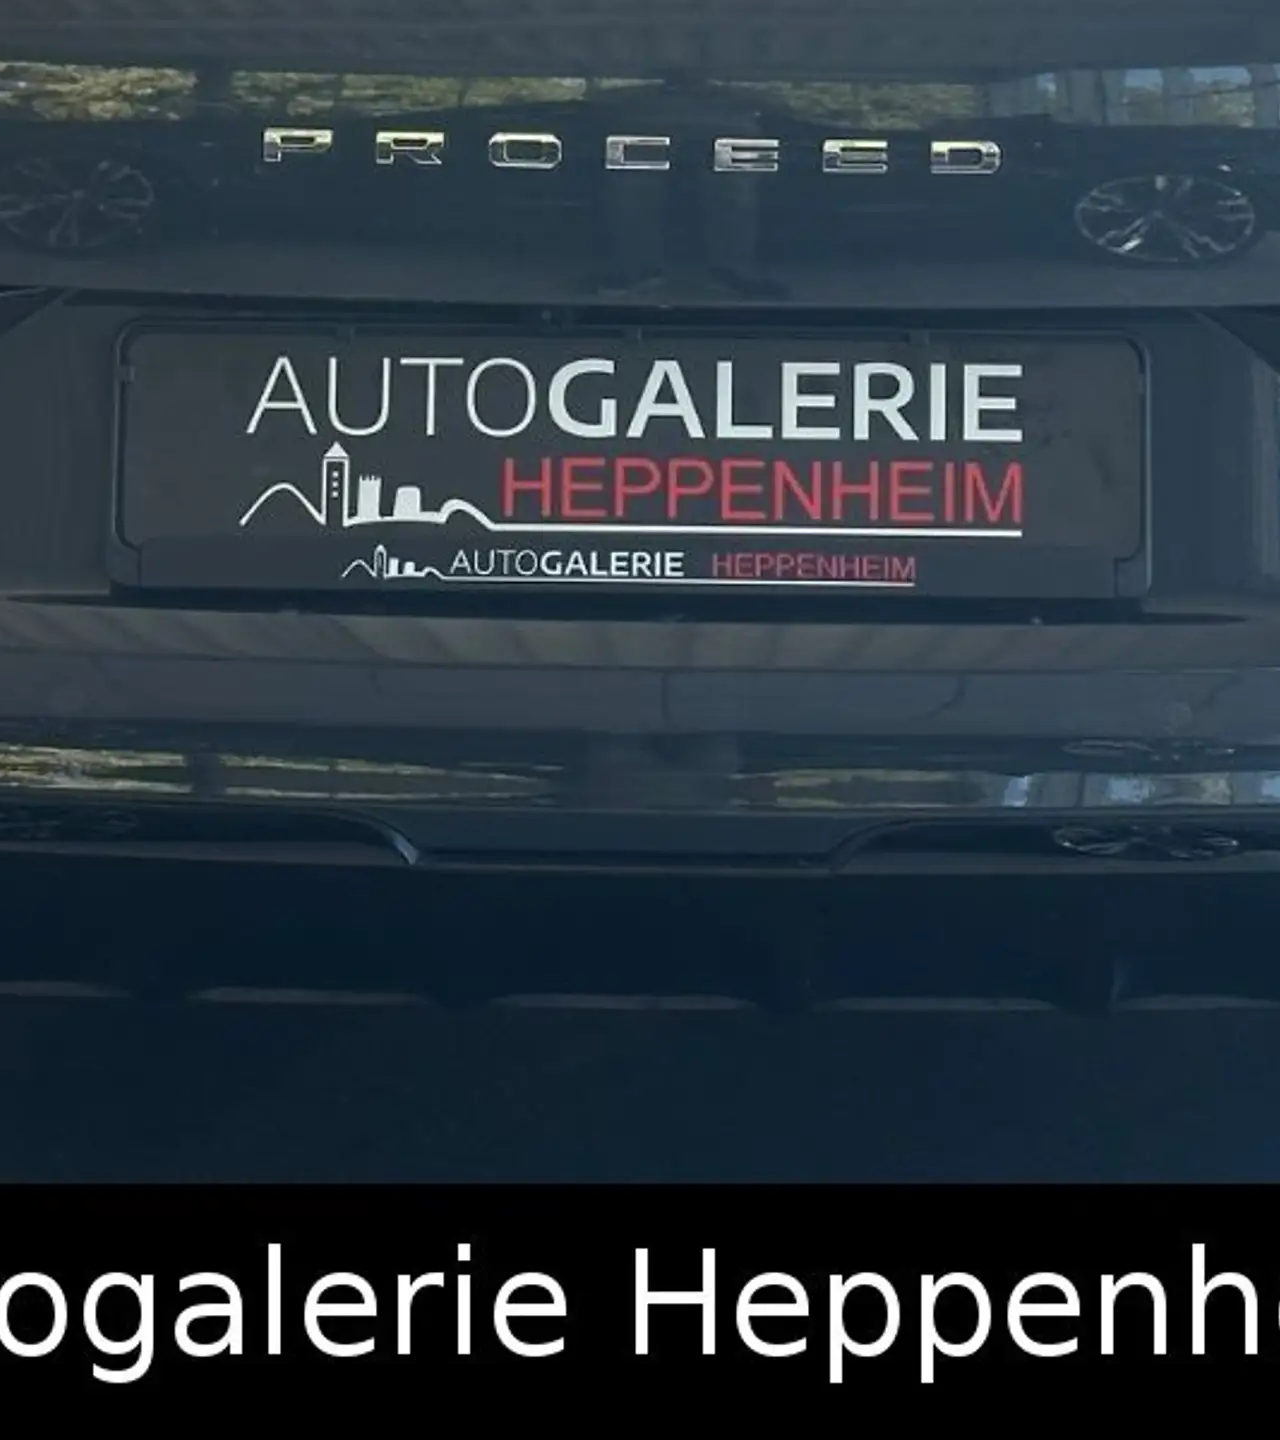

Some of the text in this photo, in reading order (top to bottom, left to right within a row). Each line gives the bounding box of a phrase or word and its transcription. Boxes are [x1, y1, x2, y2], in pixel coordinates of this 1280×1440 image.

[263, 126, 1003, 174] PROCEED
[246, 356, 1024, 441] AUTOGALERIE
[502, 456, 1023, 524] HEPPENHEIM
[449, 547, 918, 582] AUTOGALERIE HEPPENHEIM
